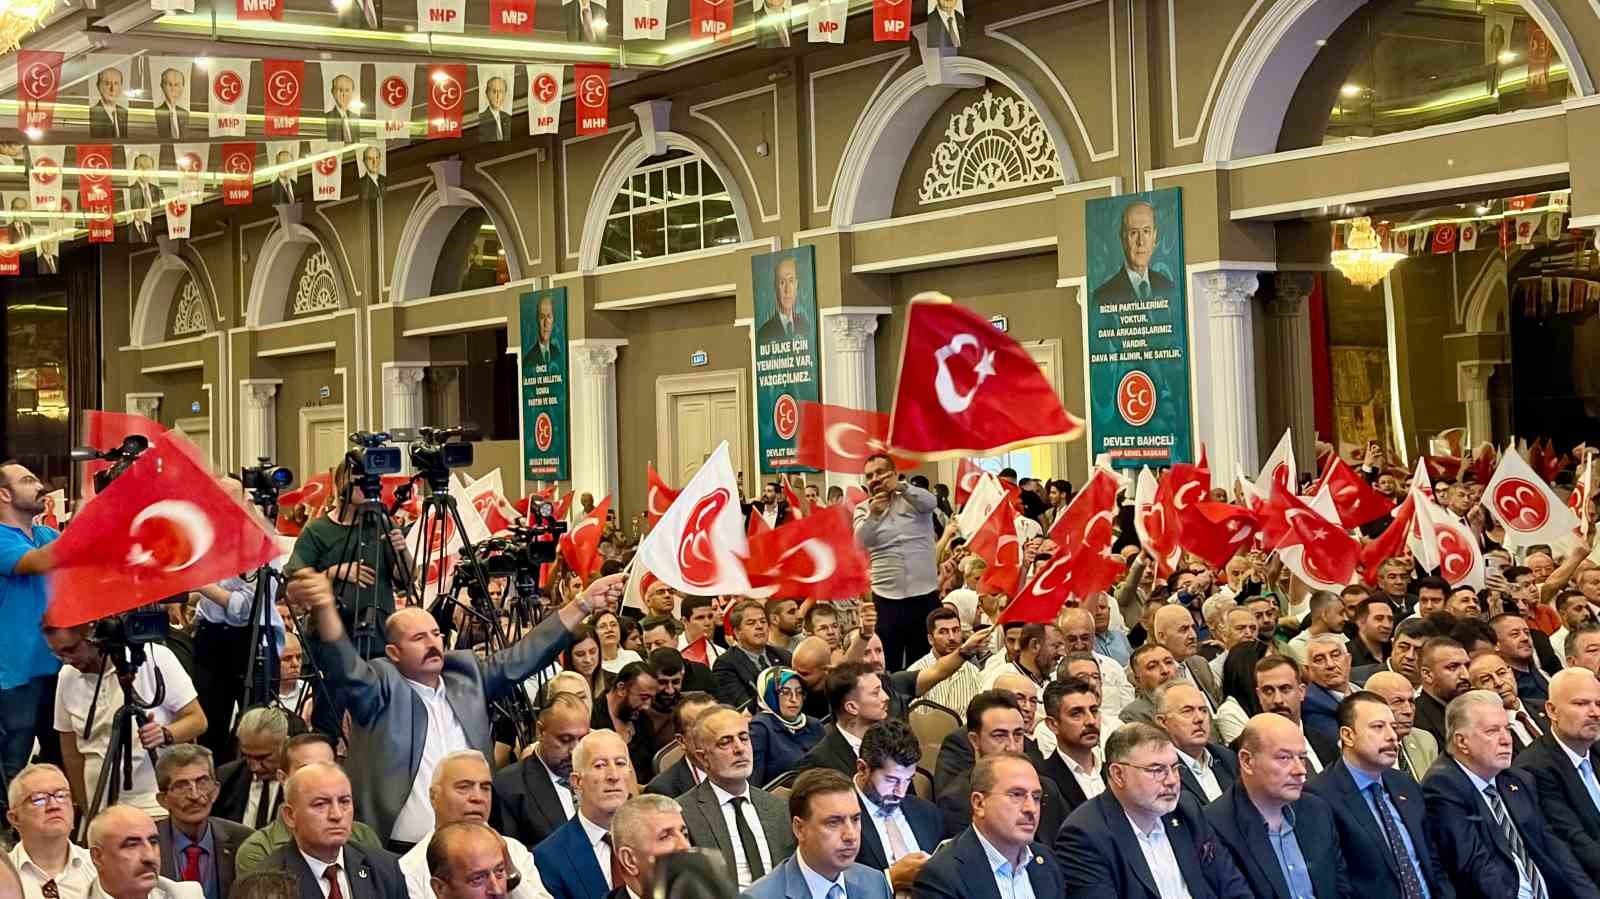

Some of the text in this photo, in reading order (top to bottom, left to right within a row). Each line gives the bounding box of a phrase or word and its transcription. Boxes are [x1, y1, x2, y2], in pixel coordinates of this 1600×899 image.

[1098, 328, 1115, 339] DAVA
[760, 344, 770, 355] BU
[1091, 354, 1108, 363] DAVA
[1103, 433, 1174, 447] DEVLET BAHÇELİ
